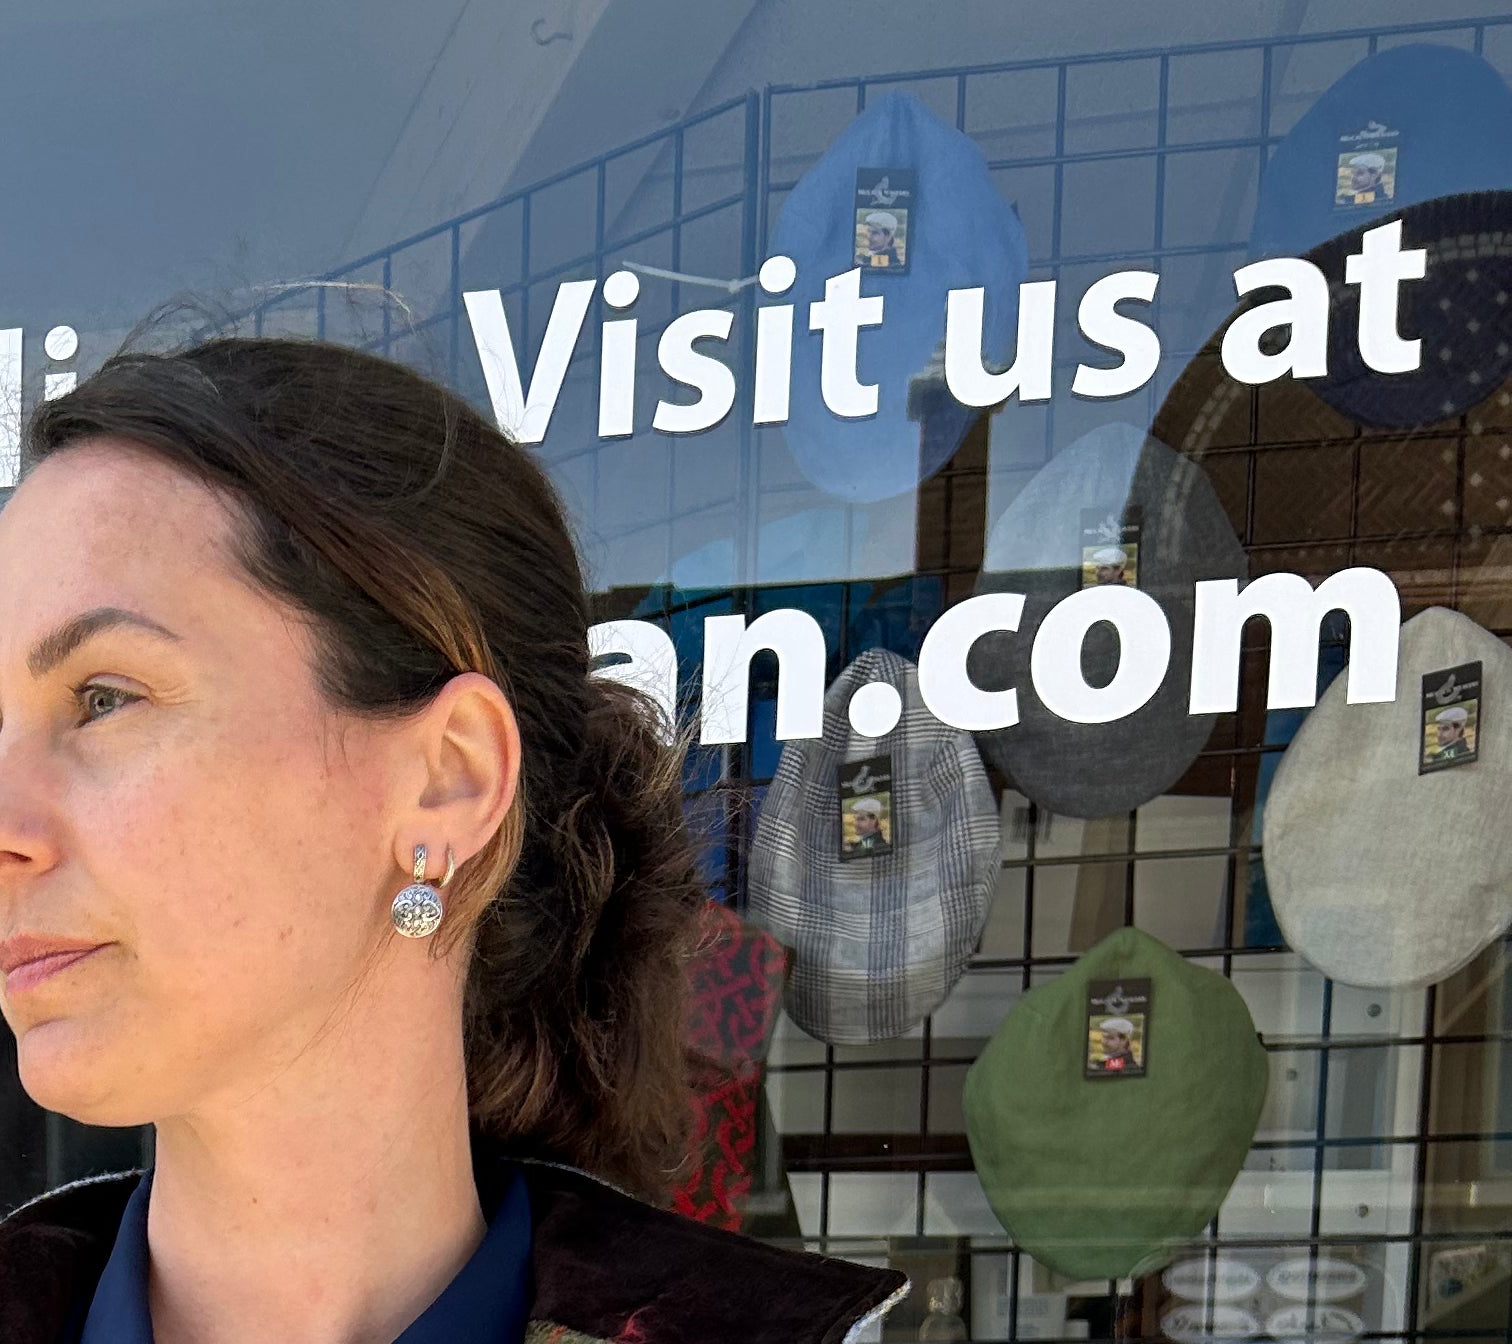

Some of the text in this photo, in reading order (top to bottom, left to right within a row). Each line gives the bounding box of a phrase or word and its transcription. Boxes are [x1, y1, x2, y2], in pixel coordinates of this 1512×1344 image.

[463, 219, 1427, 443] Visit us at
